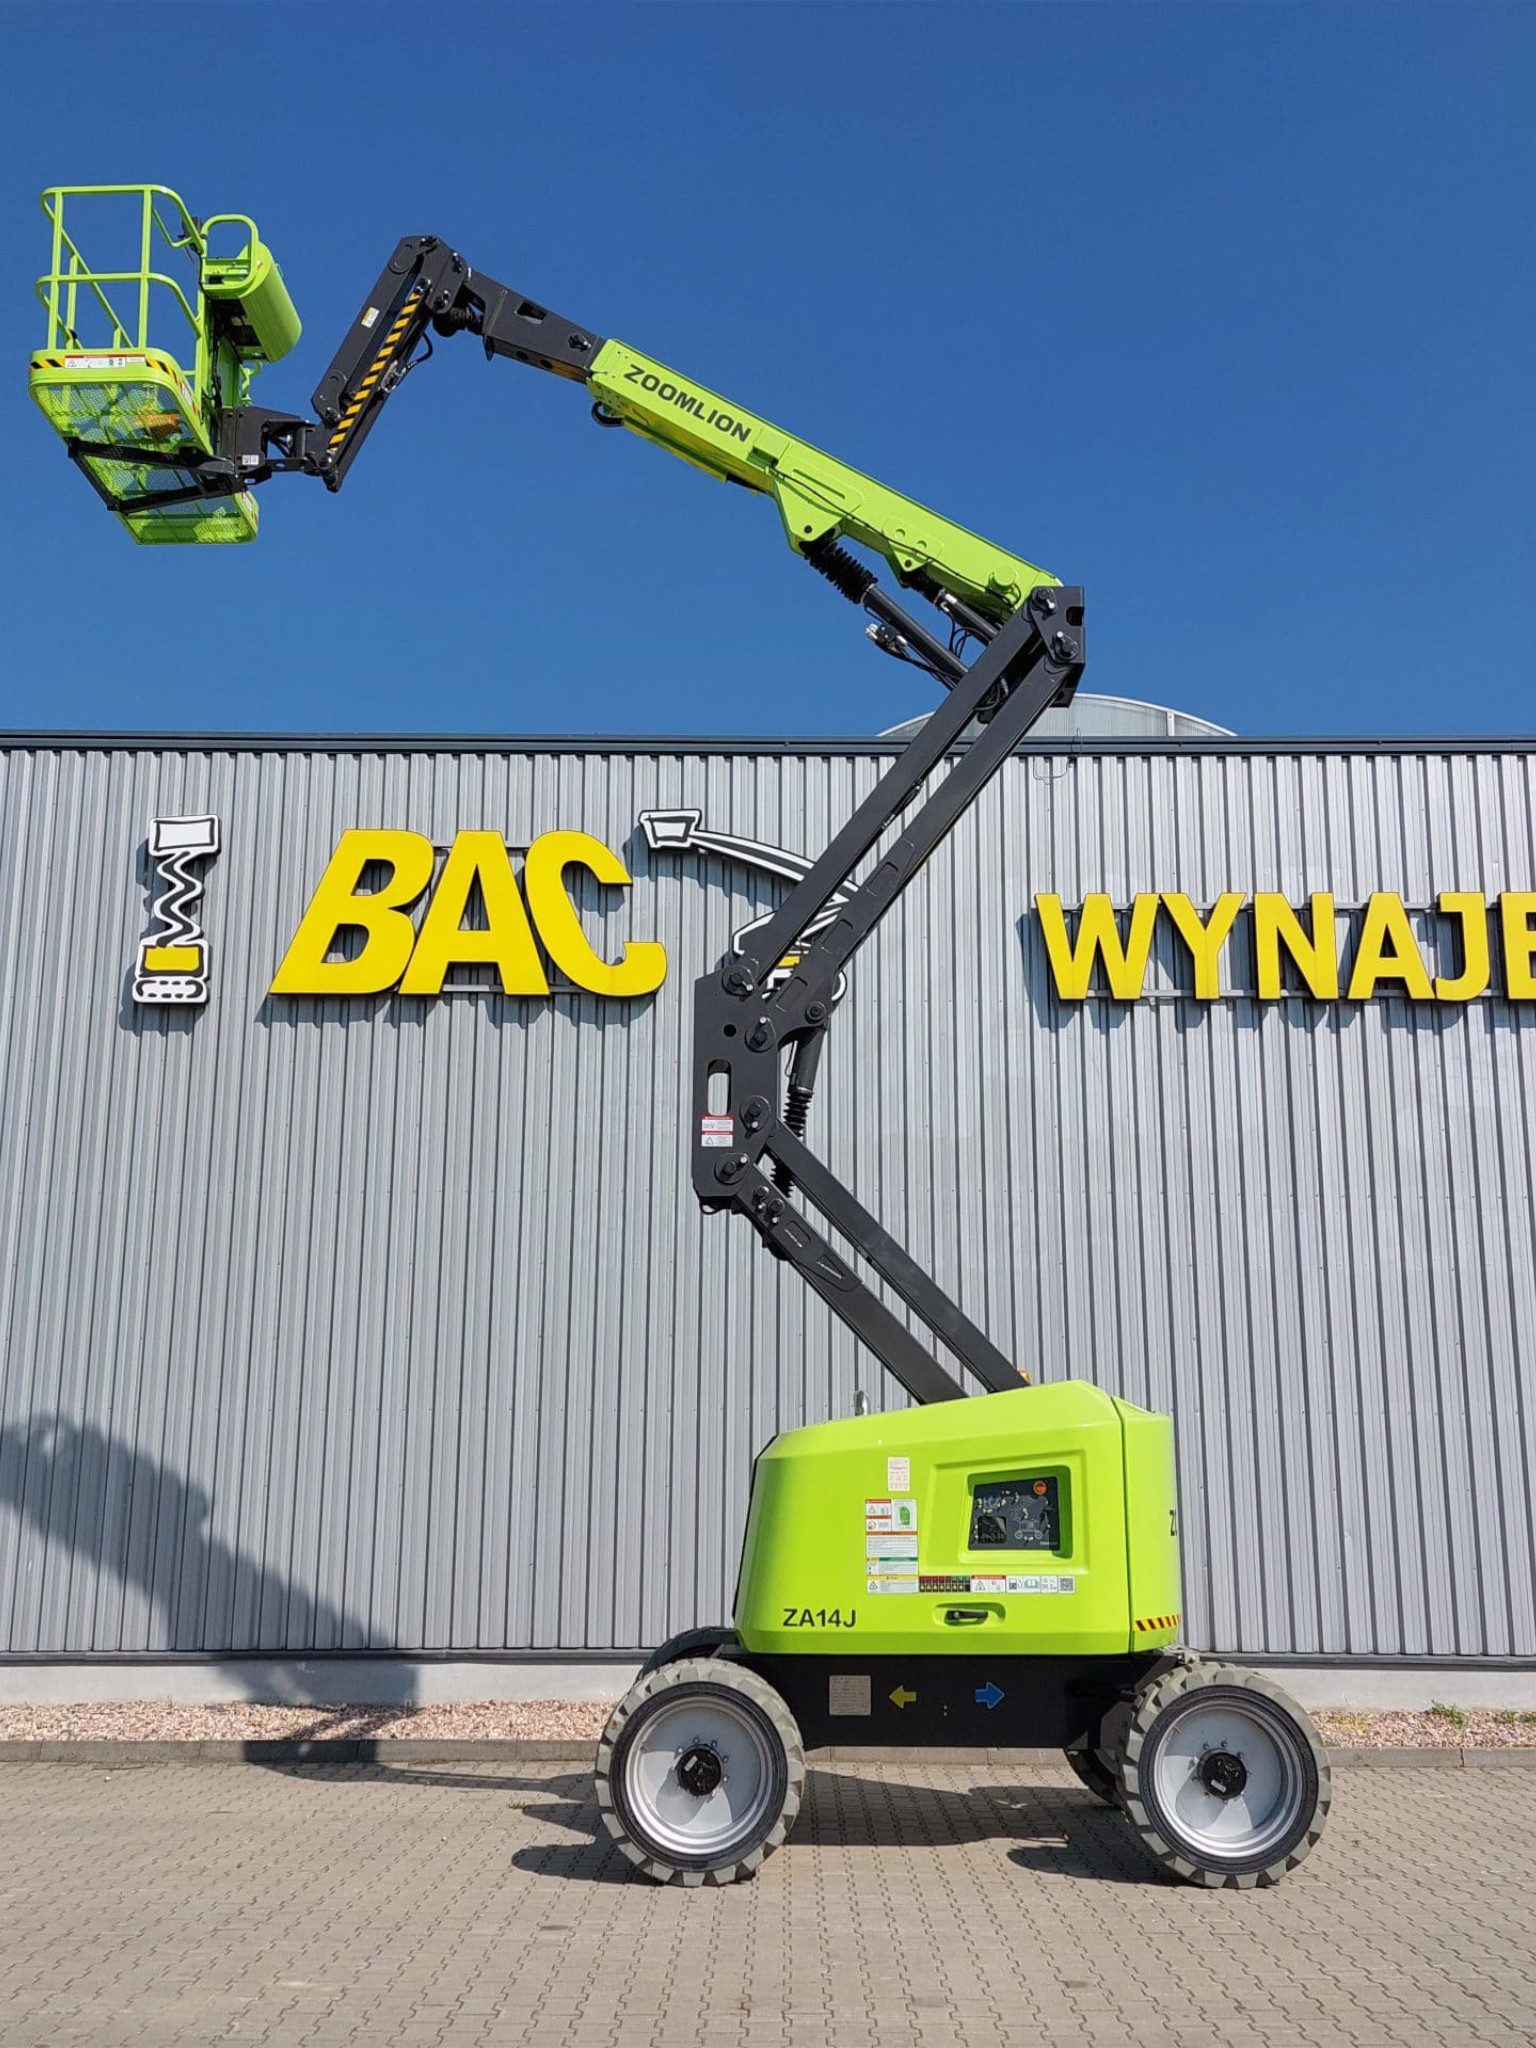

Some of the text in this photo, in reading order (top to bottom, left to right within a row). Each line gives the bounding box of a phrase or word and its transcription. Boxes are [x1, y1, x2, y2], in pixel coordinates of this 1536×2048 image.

[623, 363, 752, 442] ZOOMLION
[270, 829, 668, 997] BAC
[1035, 892, 1536, 1001] WYNAJE
[782, 1608, 857, 1628] ZA14J
